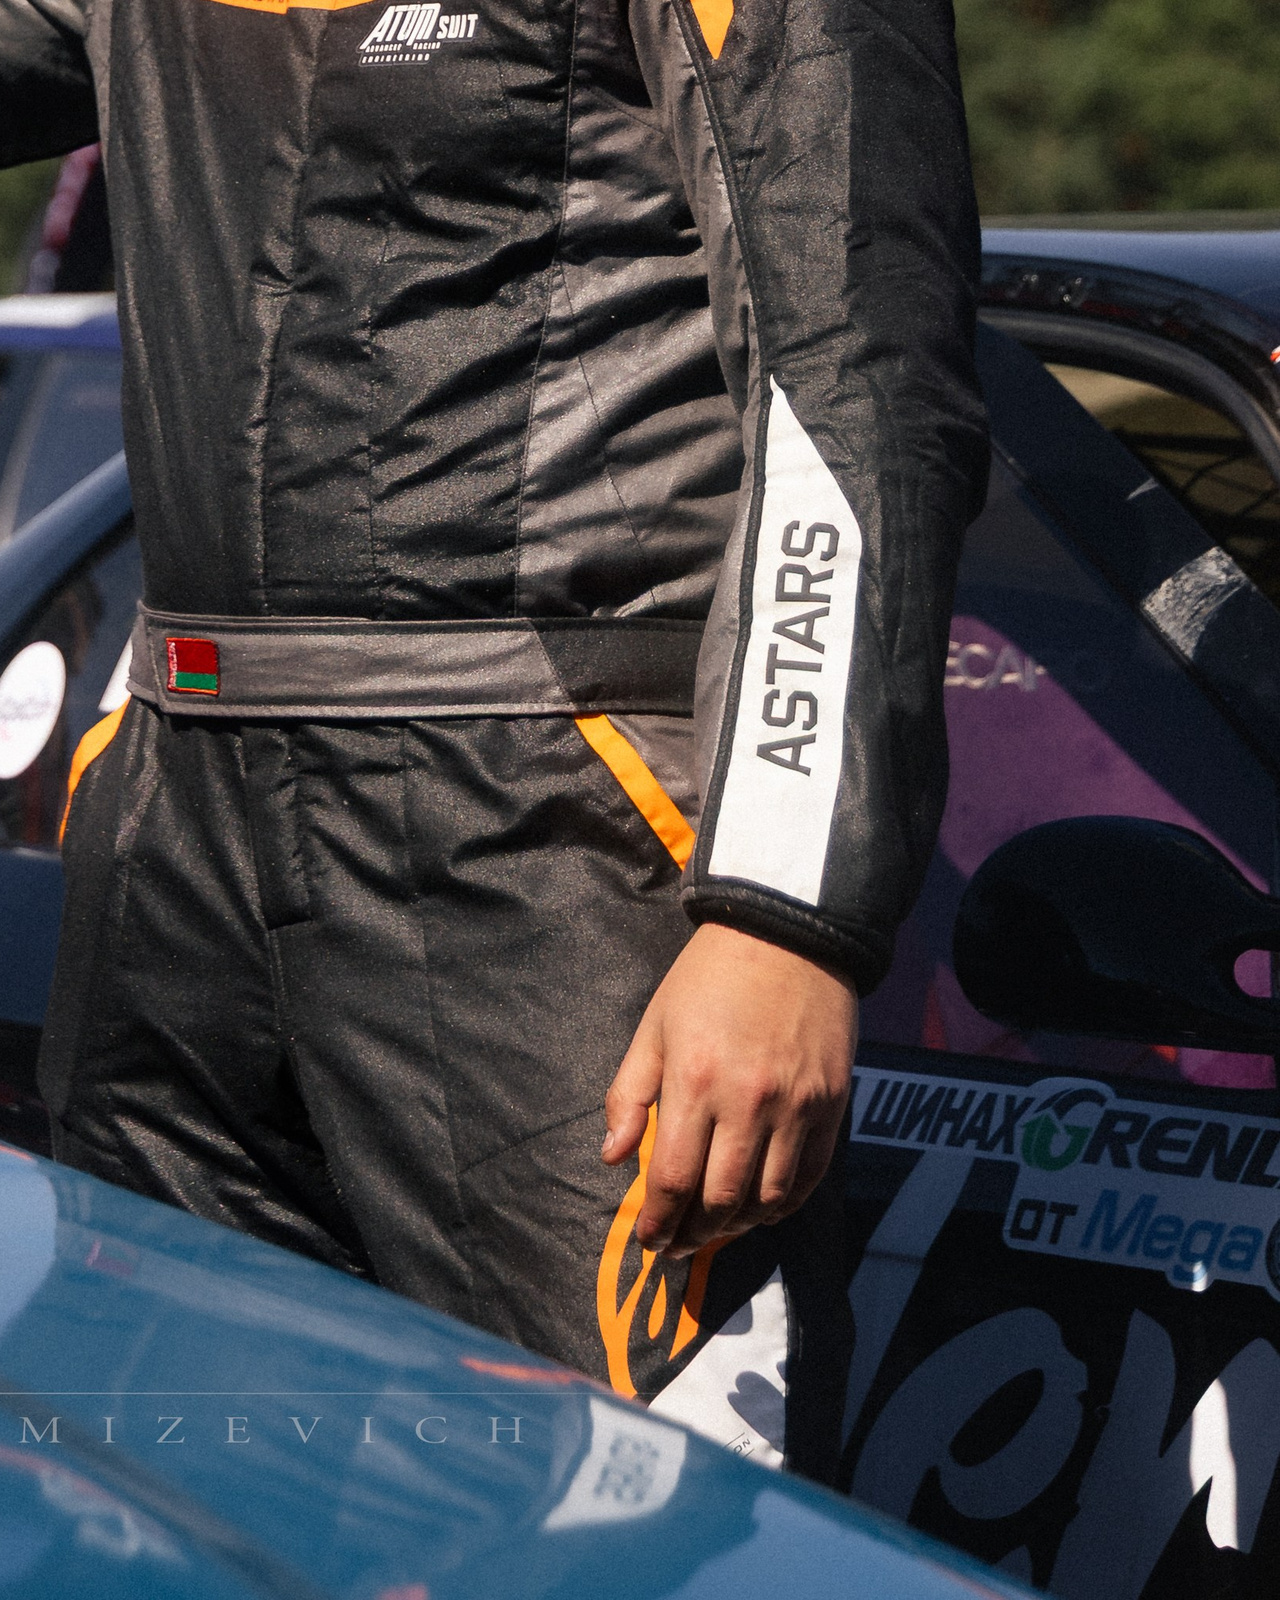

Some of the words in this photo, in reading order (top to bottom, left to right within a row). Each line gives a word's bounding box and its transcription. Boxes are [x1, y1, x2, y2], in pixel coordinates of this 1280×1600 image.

[359, 3, 441, 50] ATOM
[437, 13, 478, 40] SUIT
[756, 520, 840, 777] ASTARS
[857, 1078, 1034, 1155] ШИНАХ
[1021, 1088, 1280, 1189] GRENL
[1080, 1188, 1264, 1284] Mega
